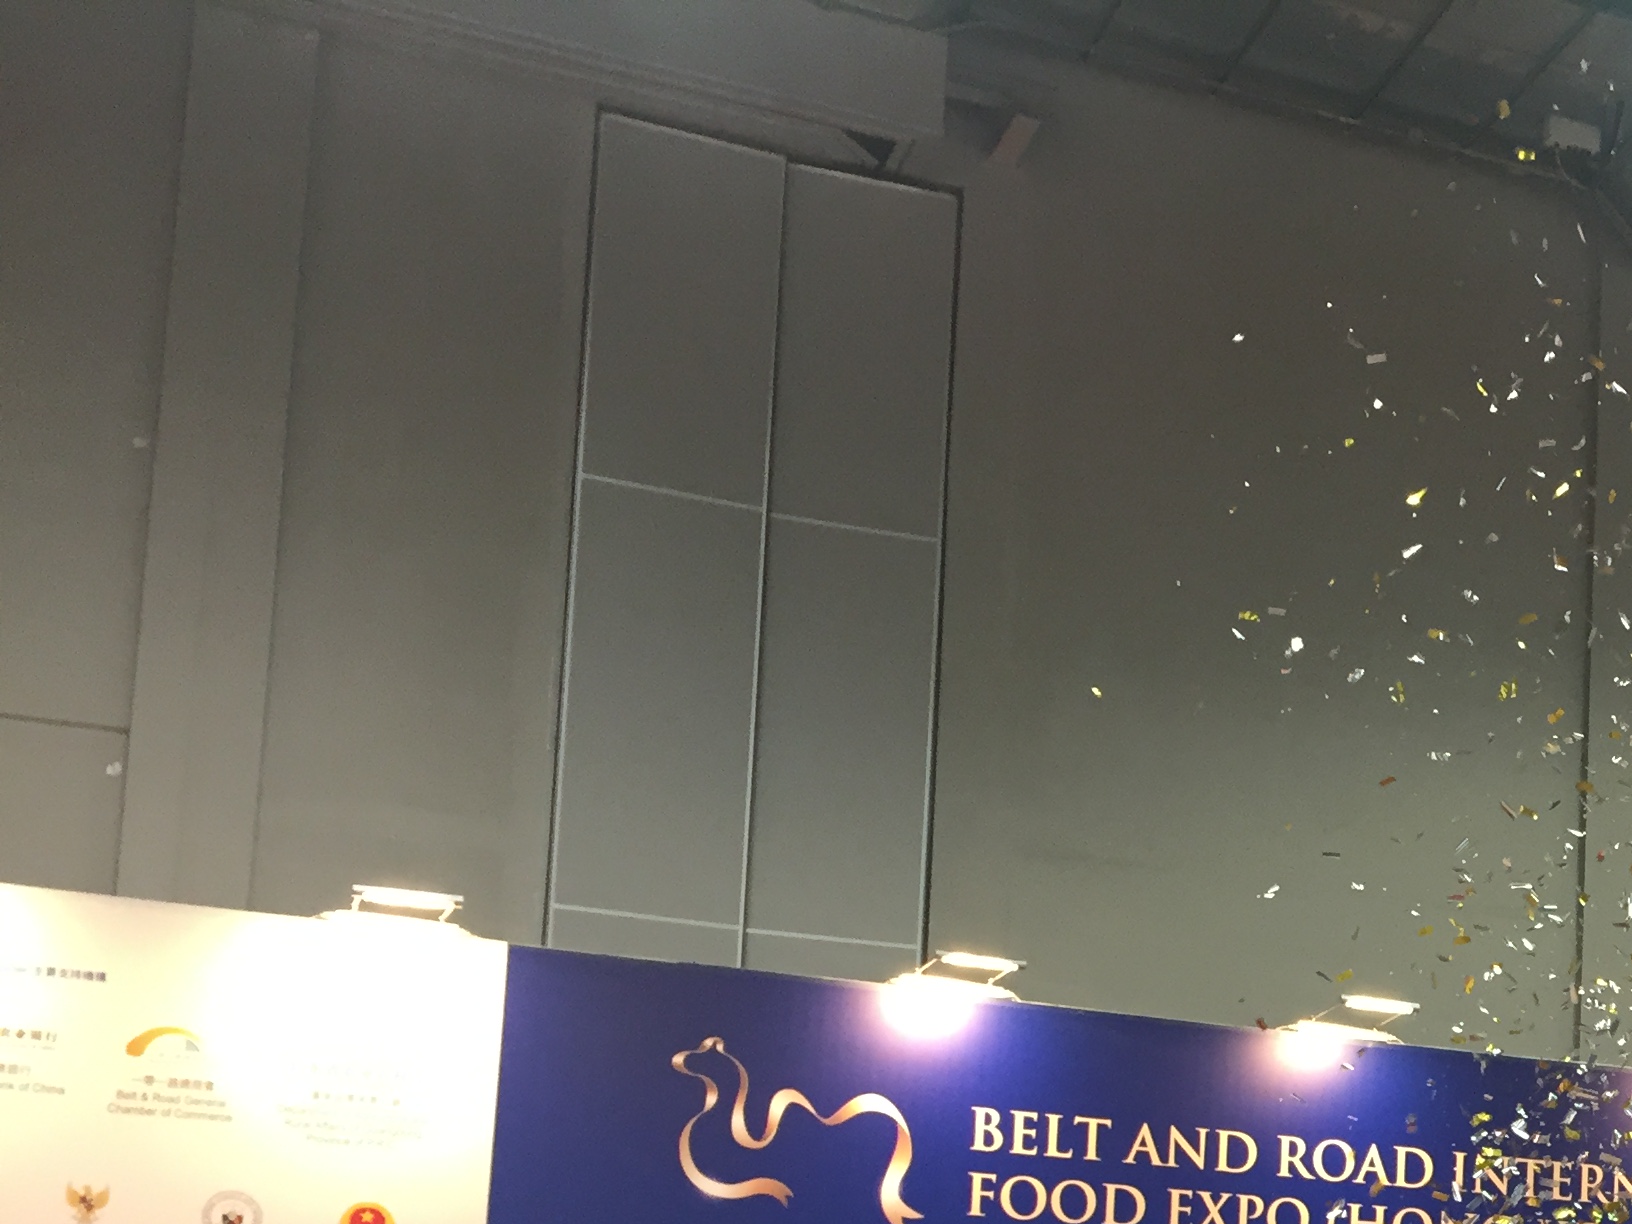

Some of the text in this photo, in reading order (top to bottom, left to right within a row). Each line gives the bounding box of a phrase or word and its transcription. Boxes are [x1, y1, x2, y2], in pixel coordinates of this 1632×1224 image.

[969, 1105, 1112, 1161] BELT
[1122, 1122, 1258, 1174] AND
[1276, 1134, 1434, 1189] ROAD
